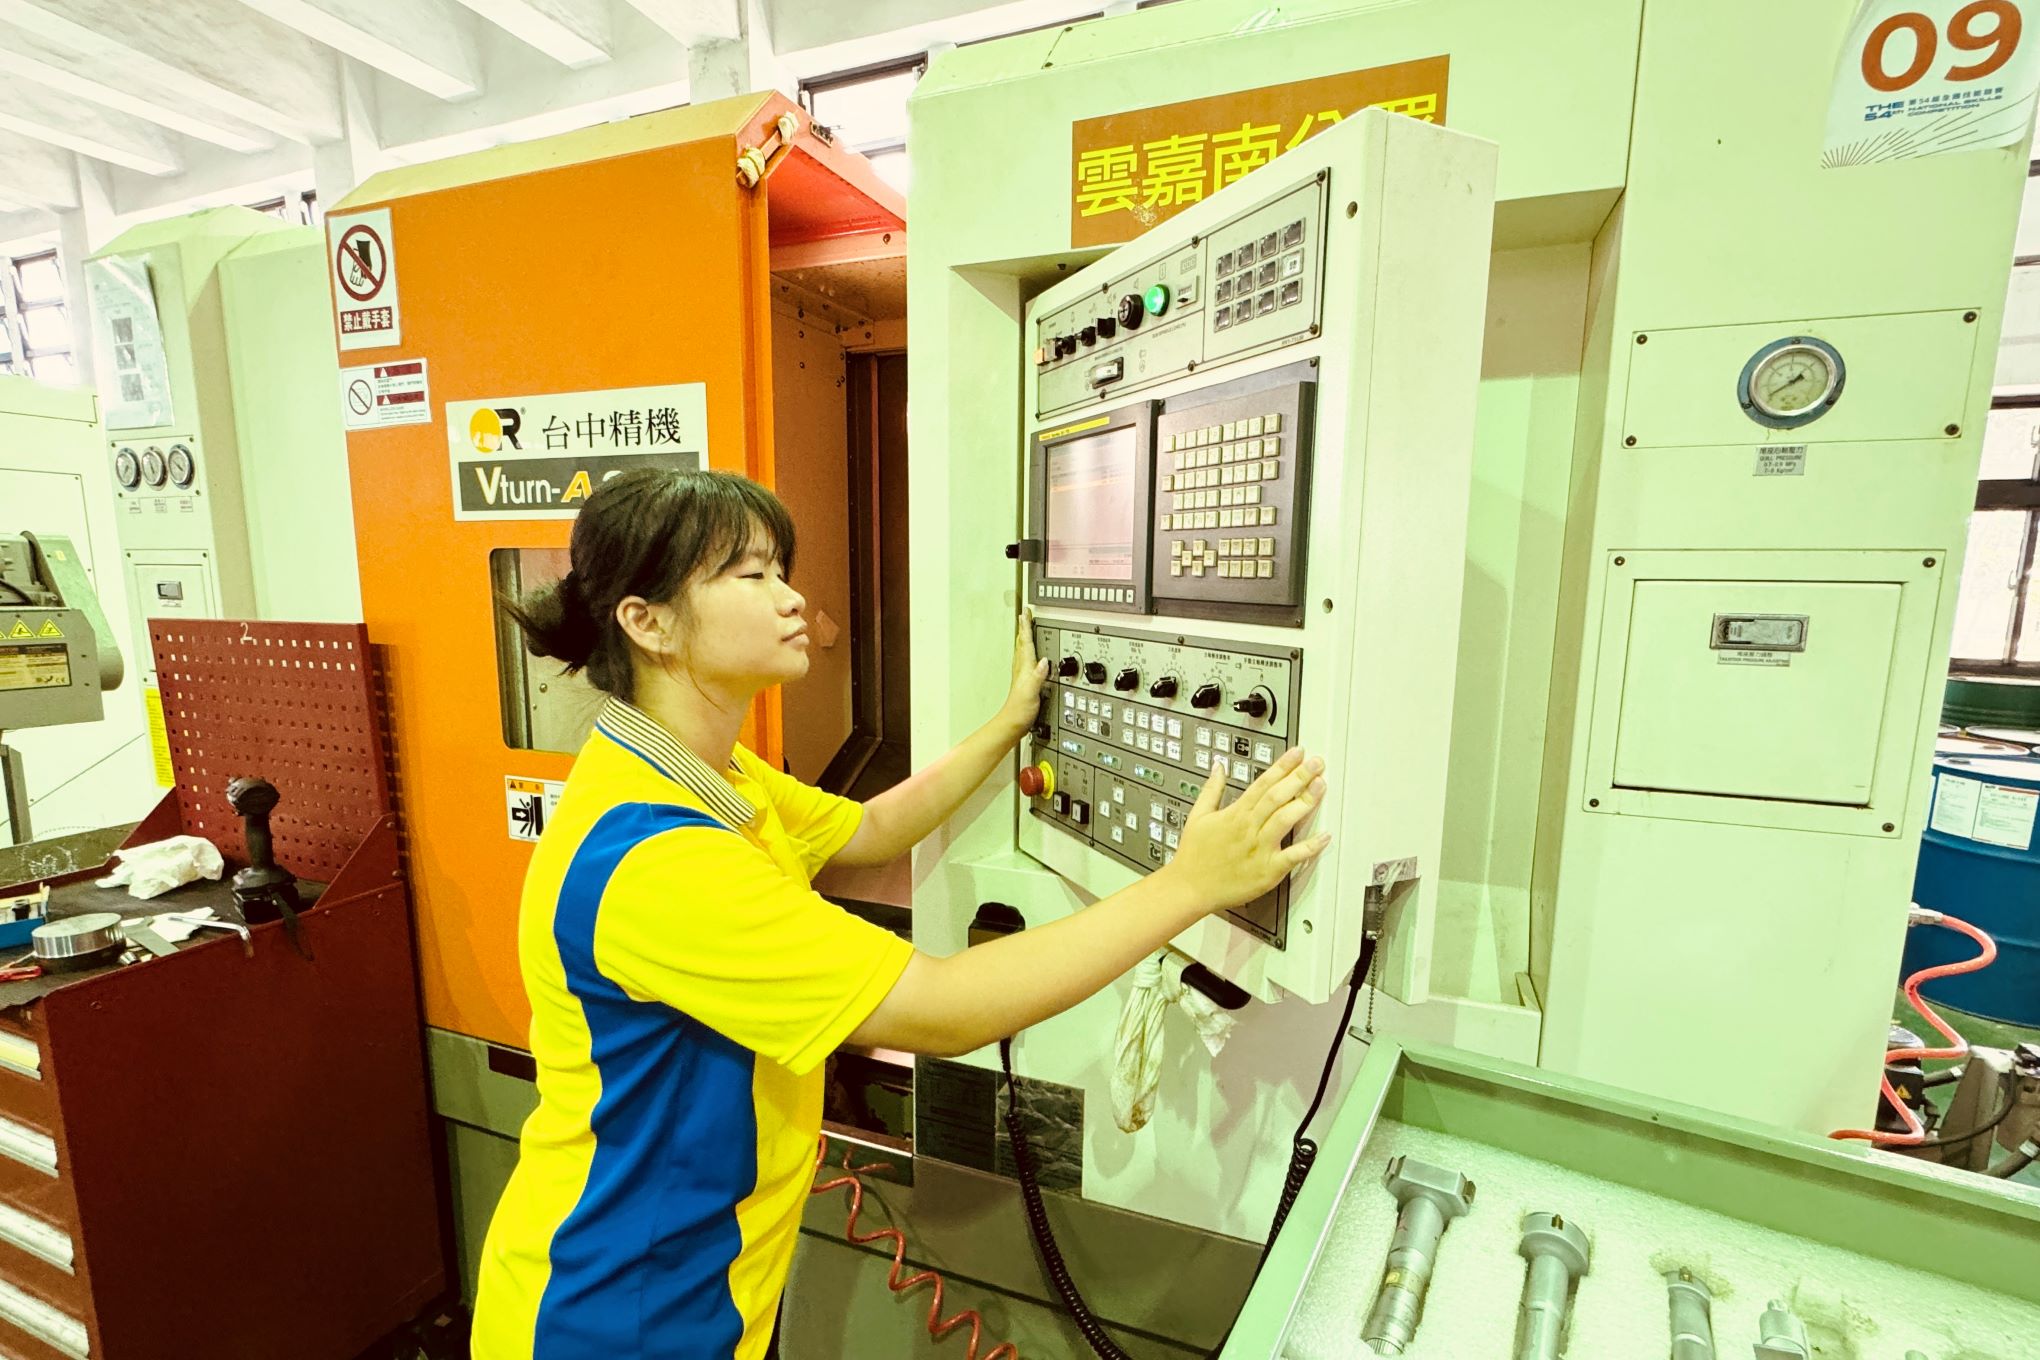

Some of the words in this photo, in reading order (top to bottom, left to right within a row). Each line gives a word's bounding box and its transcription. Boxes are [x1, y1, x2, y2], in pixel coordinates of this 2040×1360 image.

[1861, 0, 2022, 92] 09
[1865, 101, 1905, 112] THE
[343, 308, 391, 332] 禁止戴手套
[542, 407, 681, 450] 台中精機
